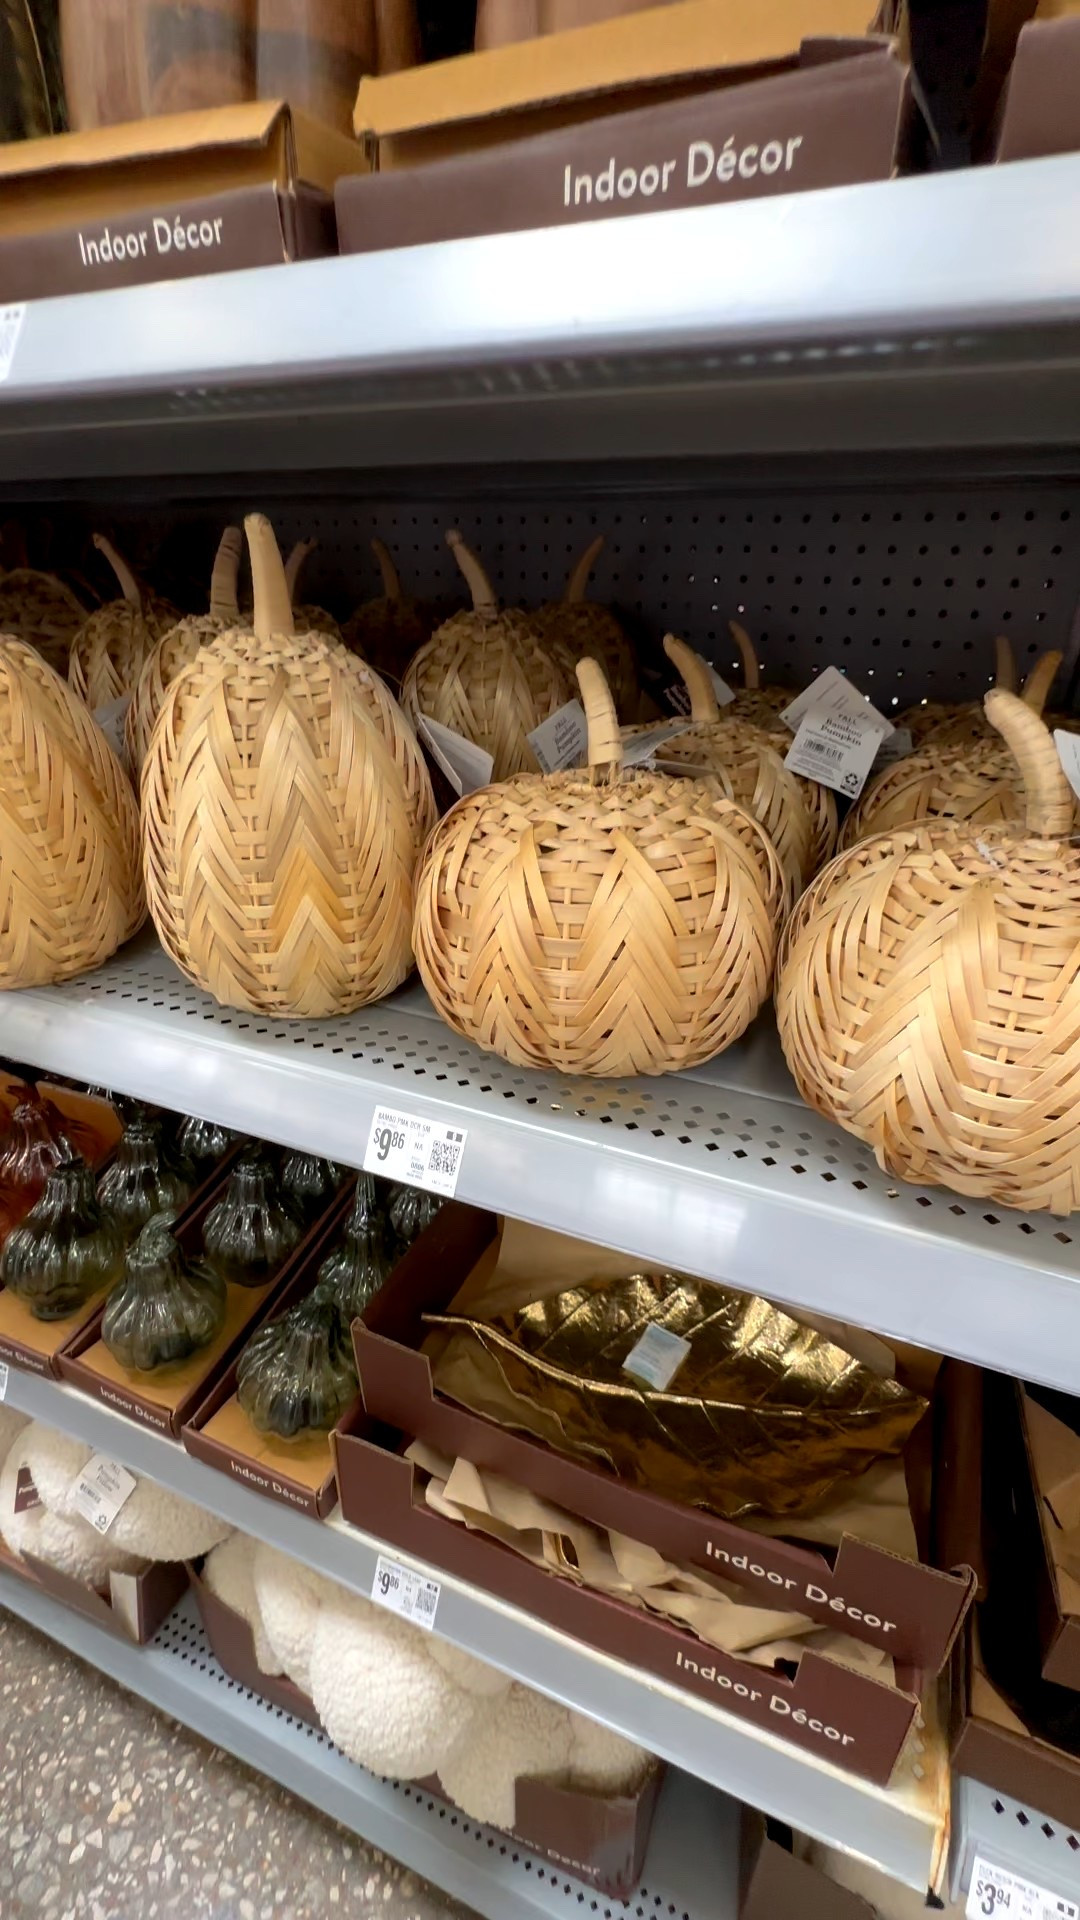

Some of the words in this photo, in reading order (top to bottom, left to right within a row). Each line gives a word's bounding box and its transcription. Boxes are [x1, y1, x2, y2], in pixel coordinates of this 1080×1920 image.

[564, 157, 676, 206] Indoor
[687, 134, 803, 188] Décor
[78, 229, 149, 267] Indoor
[152, 215, 223, 255] Décor
[820, 724, 862, 746] Pumpkin
[100, 1386, 132, 1411] Indoor
[134, 1404, 165, 1428] Décor
[230, 1460, 269, 1488] Indoor
[272, 1481, 309, 1507] Décor
[706, 1541, 797, 1590] Indoor
[805, 1583, 897, 1633] Décor
[676, 1651, 762, 1702] Indoor
[769, 1694, 855, 1746] Décor
